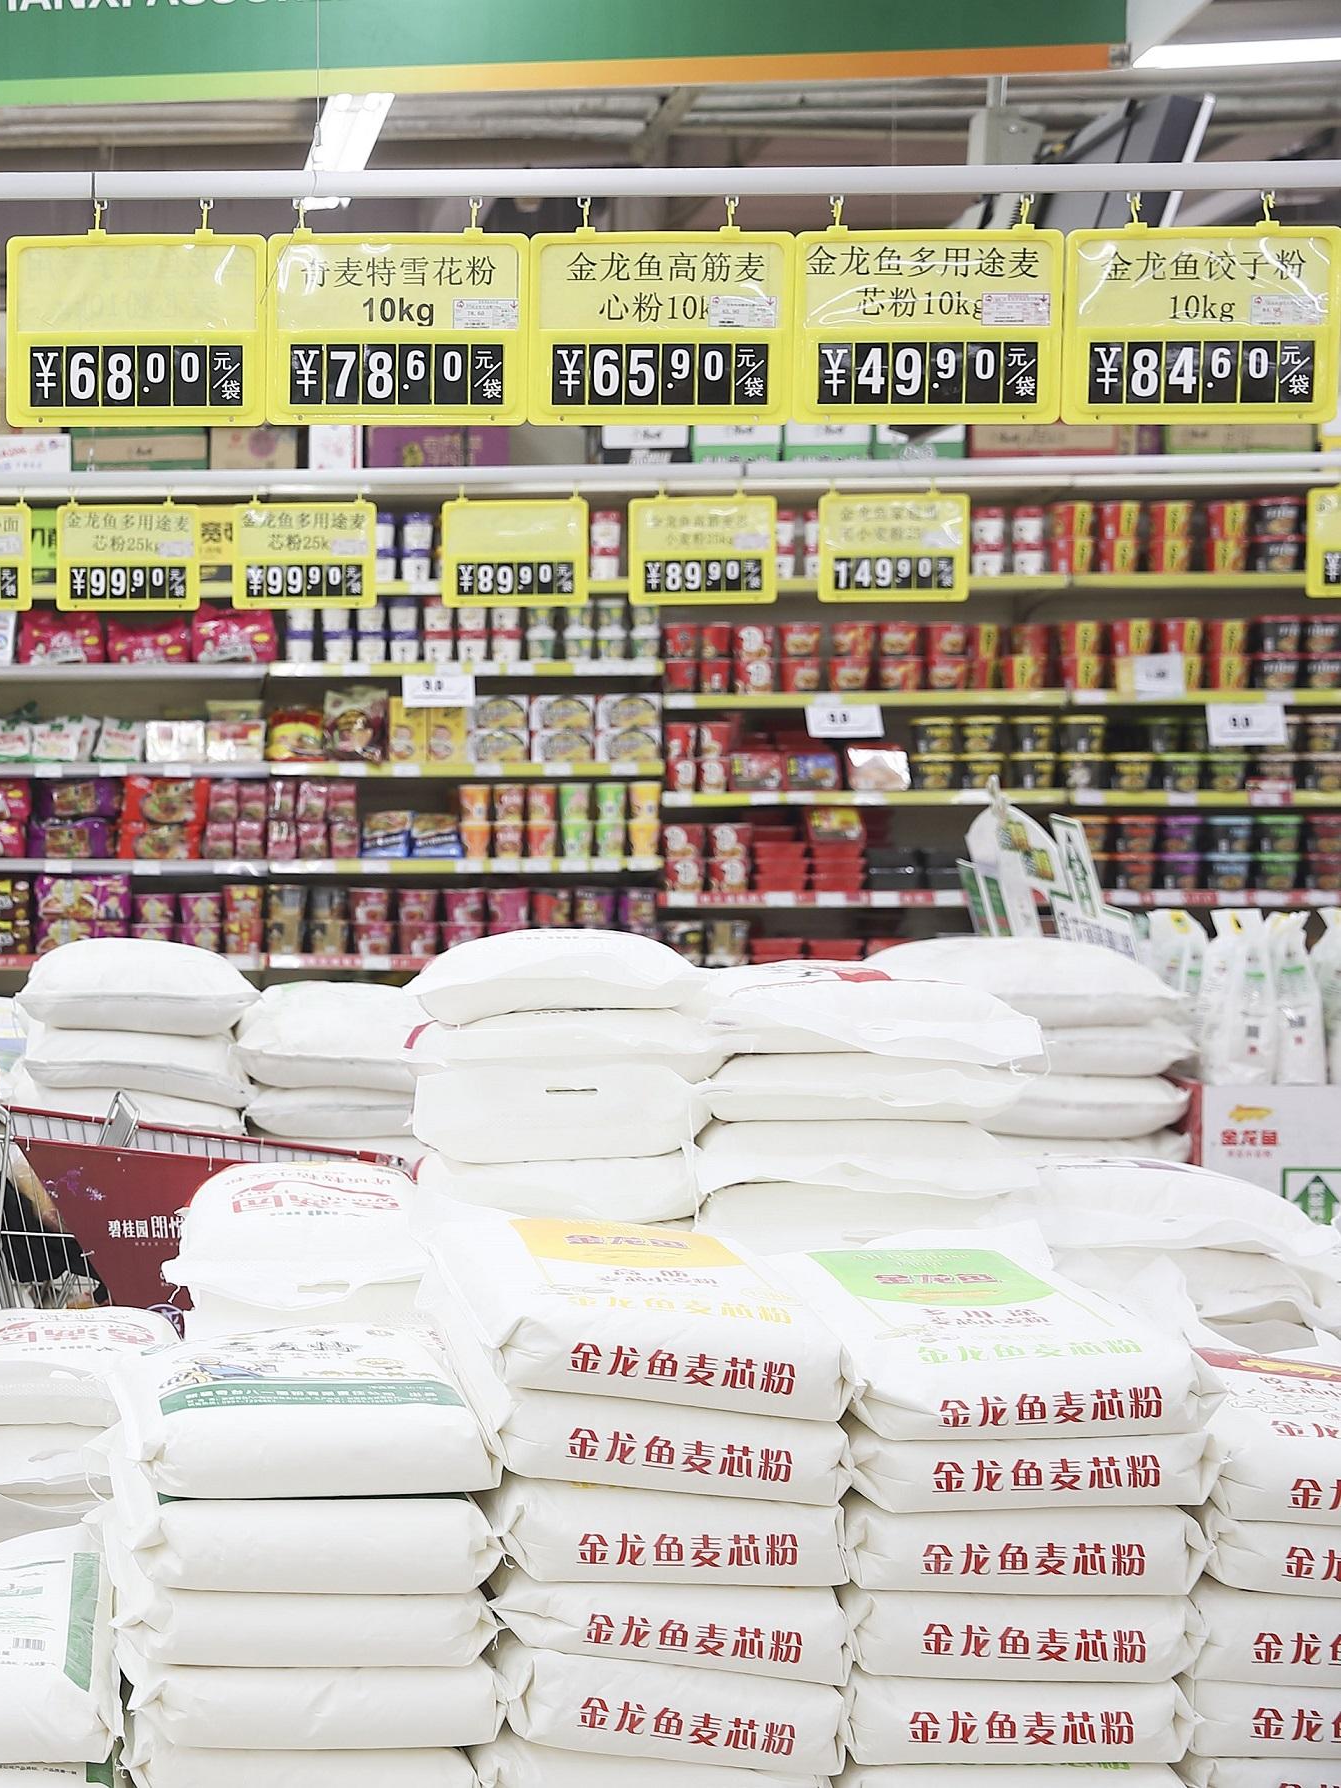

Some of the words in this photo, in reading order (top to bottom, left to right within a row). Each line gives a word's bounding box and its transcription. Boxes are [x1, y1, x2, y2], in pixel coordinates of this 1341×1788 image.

[566, 251, 765, 283] 金龙鱼高筋麦
[806, 245, 1039, 279] 金龙鱼多用途麦
[1101, 249, 1307, 282] 金龙鱼饺子粉
[362, 297, 435, 327] 10kg
[599, 292, 710, 322] 心粉10k
[856, 287, 983, 320] 芯粉10kg
[1169, 294, 1236, 323] 10kg
[32, 352, 200, 400] ¥68.00
[293, 349, 463, 399] ¥78.60
[556, 348, 725, 397] ¥65.90
[821, 347, 996, 396] ¥49.90
[1093, 346, 1270, 397] ¥84.60
[268, 534, 331, 551] 芯粉25k
[70, 568, 165, 597] ¥99.90
[247, 566, 343, 596] ¥99.90
[459, 563, 554, 594] ¥89.90
[645, 561, 740, 591] ¥89.90
[108, 1219, 149, 1239] 碧桂园
[567, 1341, 796, 1396] 金龙鱼麦芯粉
[938, 1384, 1163, 1428] 金龙鱼麦芯粉
[565, 1427, 793, 1484] 金龙鱼麦芯粉
[932, 1454, 1161, 1494] 金龙鱼麦芯粉
[576, 1533, 799, 1568] 金龙鱼麦芯粉
[920, 1542, 1147, 1577] 金龙鱼麦芯粉
[582, 1613, 803, 1665] 金龙鱼麦芯粉
[920, 1622, 1148, 1665] 金龙鱼麦芯粉
[577, 1697, 796, 1756] 金龙鱼麦芯粉
[908, 1710, 1135, 1745] 金龙鱼麦芯粉
